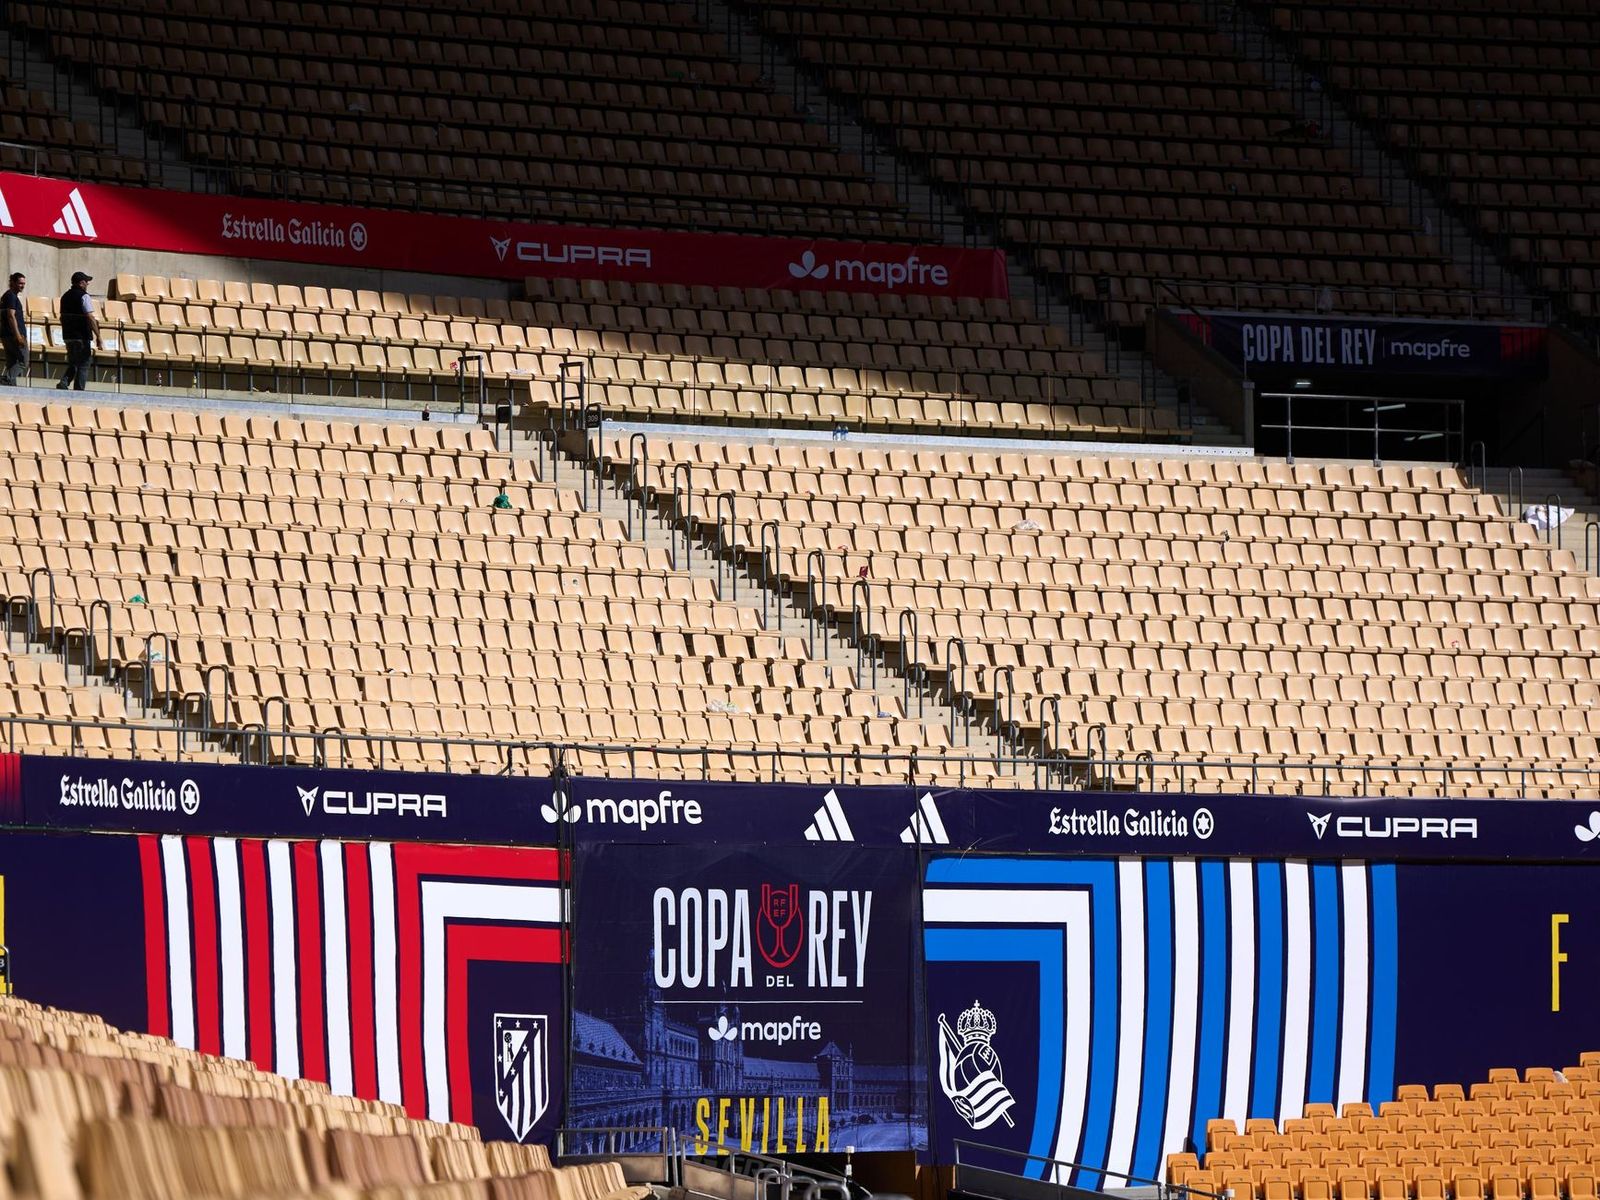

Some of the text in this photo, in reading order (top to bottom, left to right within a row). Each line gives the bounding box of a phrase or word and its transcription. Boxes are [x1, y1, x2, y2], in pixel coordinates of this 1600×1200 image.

[221, 212, 346, 248] Estrella Galicia
[516, 241, 651, 268] CUPRA
[835, 255, 949, 290] mapfre
[1242, 323, 1377, 366] COPA DEL REY
[1390, 338, 1471, 361] mapfre
[59, 774, 177, 812] Estrella Galicia
[322, 790, 447, 818] CUPRA
[586, 790, 703, 831] mapfre
[1048, 806, 1189, 838] Estrella Galicia
[1336, 816, 1478, 839] CUPRA
[653, 886, 873, 988] COPA REY
[766, 975, 795, 988] DEL
[741, 1016, 822, 1045] mapfre
[694, 1096, 830, 1157] SEVILLA
